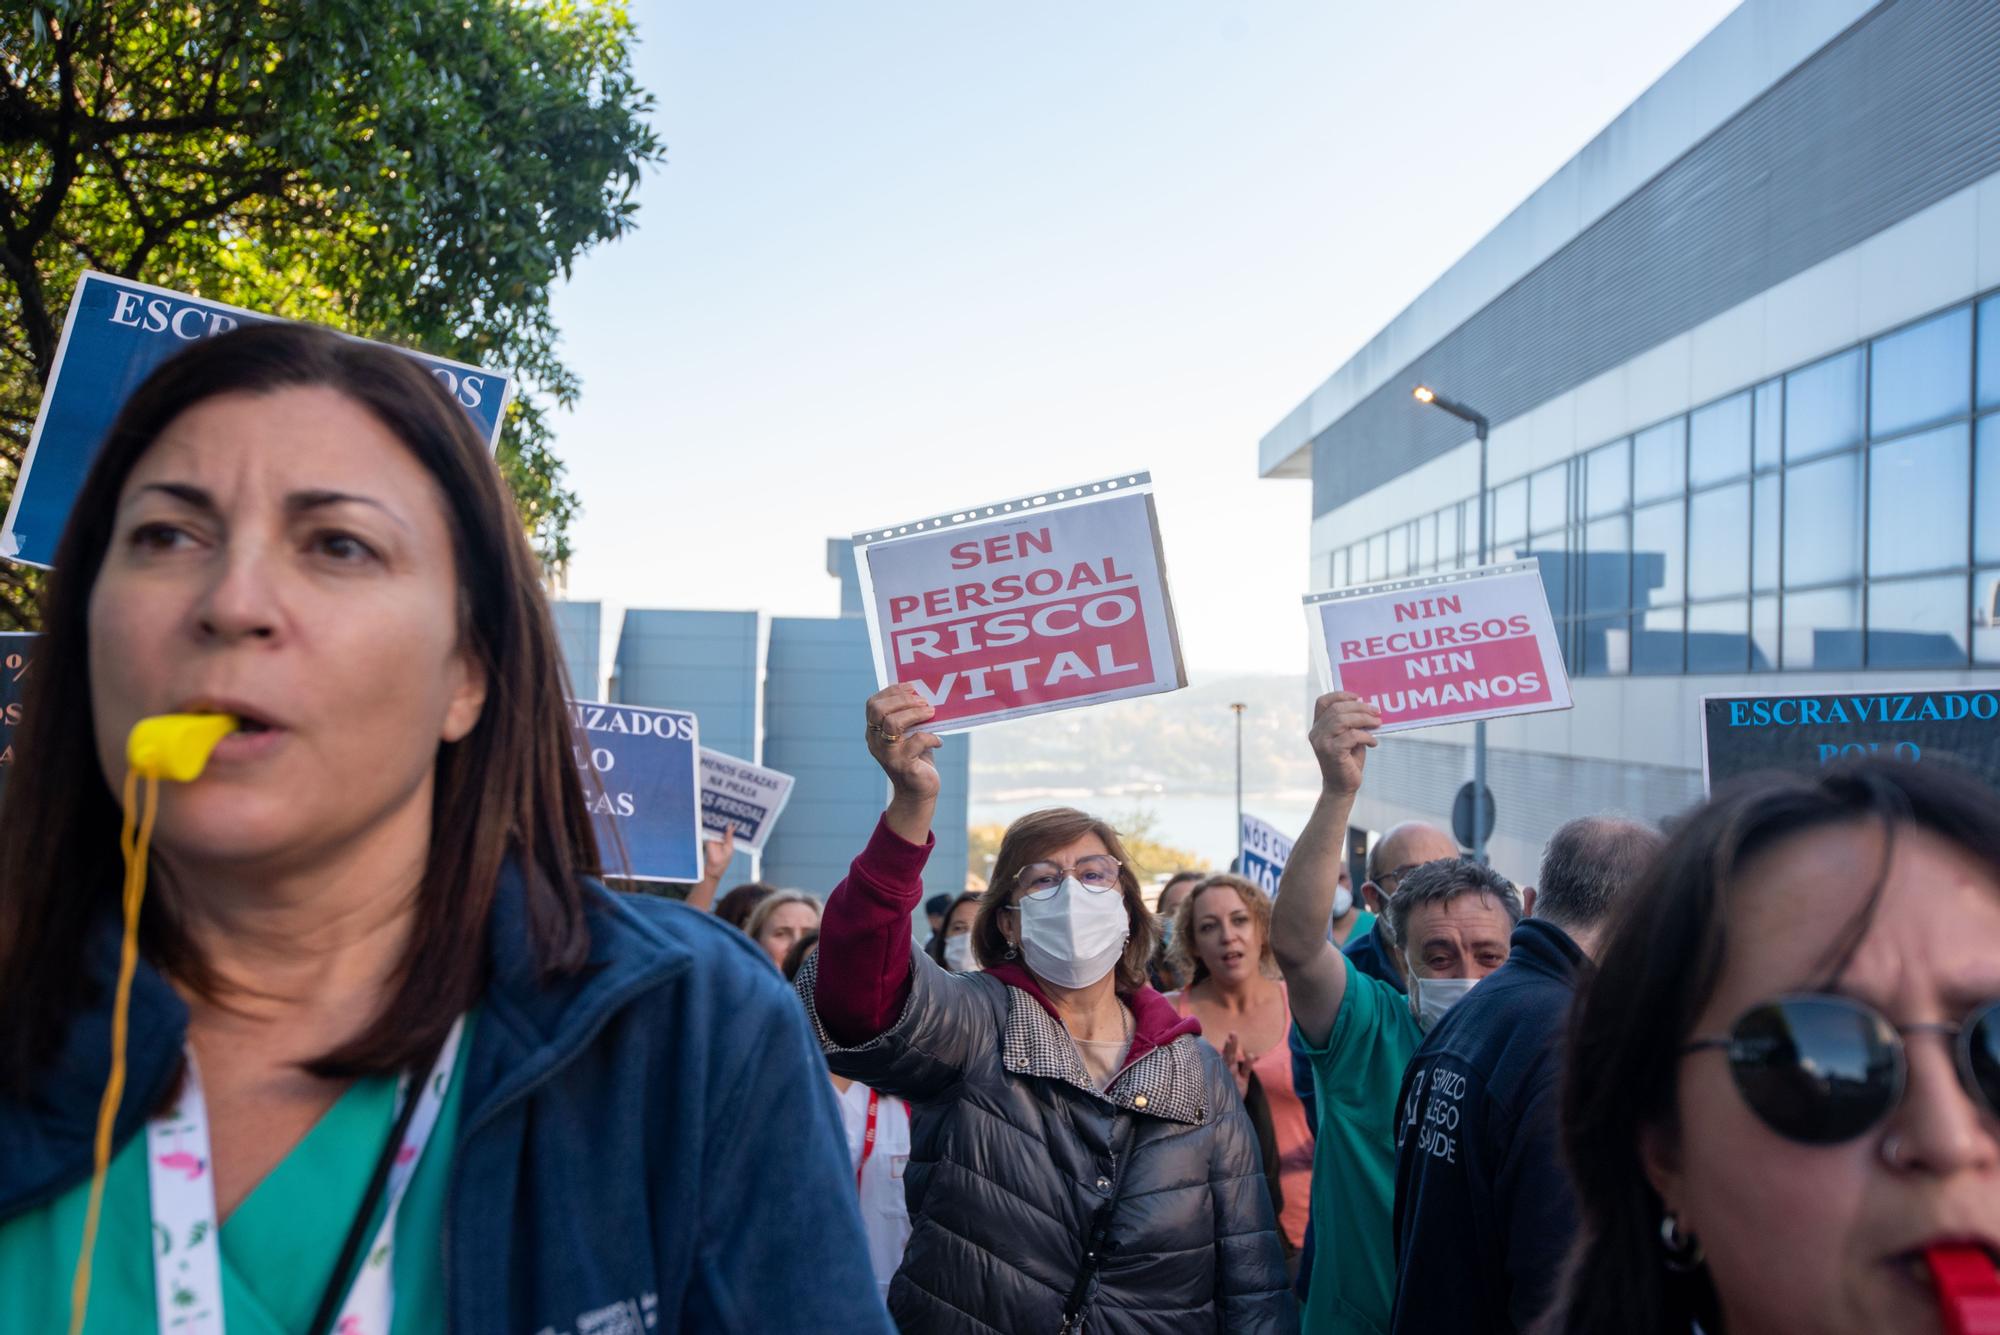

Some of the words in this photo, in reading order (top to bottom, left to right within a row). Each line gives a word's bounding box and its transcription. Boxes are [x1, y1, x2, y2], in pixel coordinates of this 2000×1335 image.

[950, 527, 1054, 570] SEN
[889, 557, 1133, 624] PERSOAL
[1394, 595, 1462, 622] NIN
[897, 594, 1136, 665] RISCO
[1340, 615, 1531, 660] RECURSOS
[911, 644, 1138, 706] VITAL
[1405, 651, 1475, 679] NIN
[568, 706, 692, 741] IZADOS
[1728, 693, 1999, 726] ESCRAVIZADO
[1248, 860, 1281, 898] VÓ
